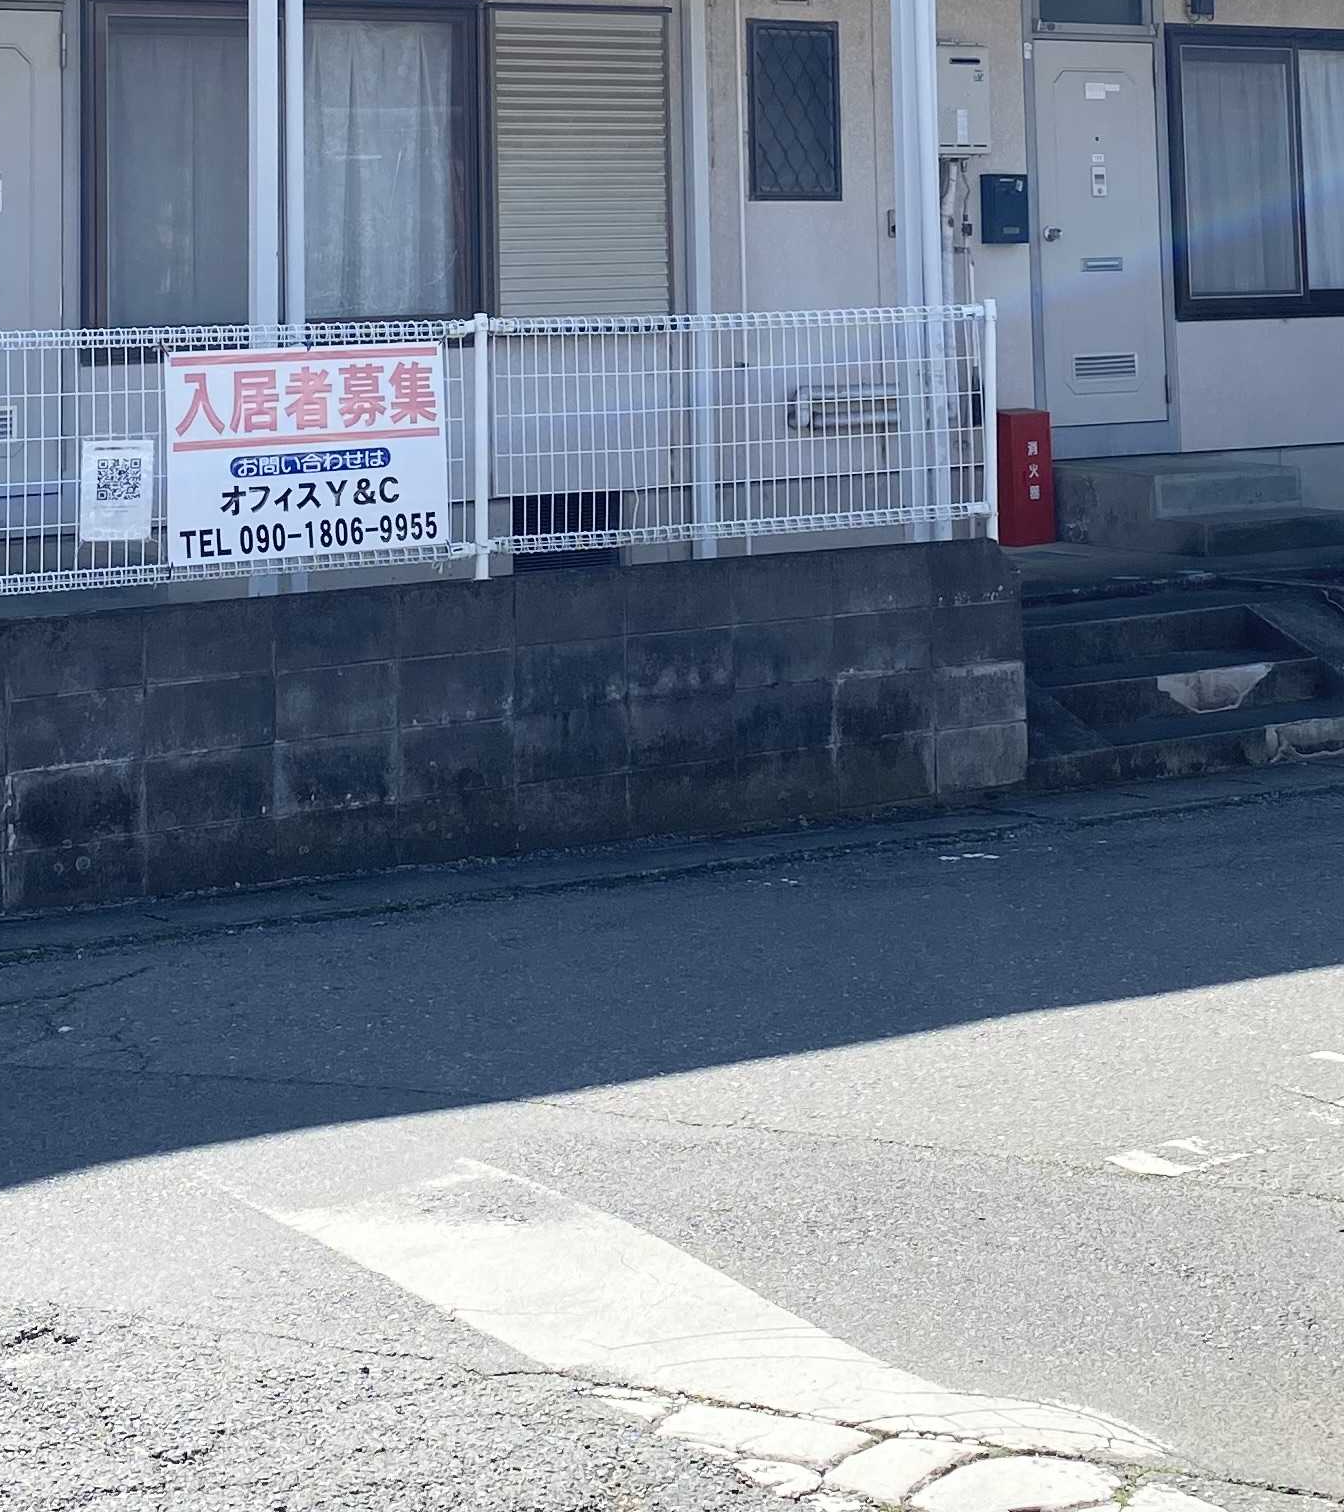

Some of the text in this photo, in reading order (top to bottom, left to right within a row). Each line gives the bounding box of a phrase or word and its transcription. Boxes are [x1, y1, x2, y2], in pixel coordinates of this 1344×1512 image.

[174, 361, 438, 437] 入居者募集
[237, 449, 385, 476] お問い合わせは
[179, 511, 438, 558] TEL 090-1806-9955
